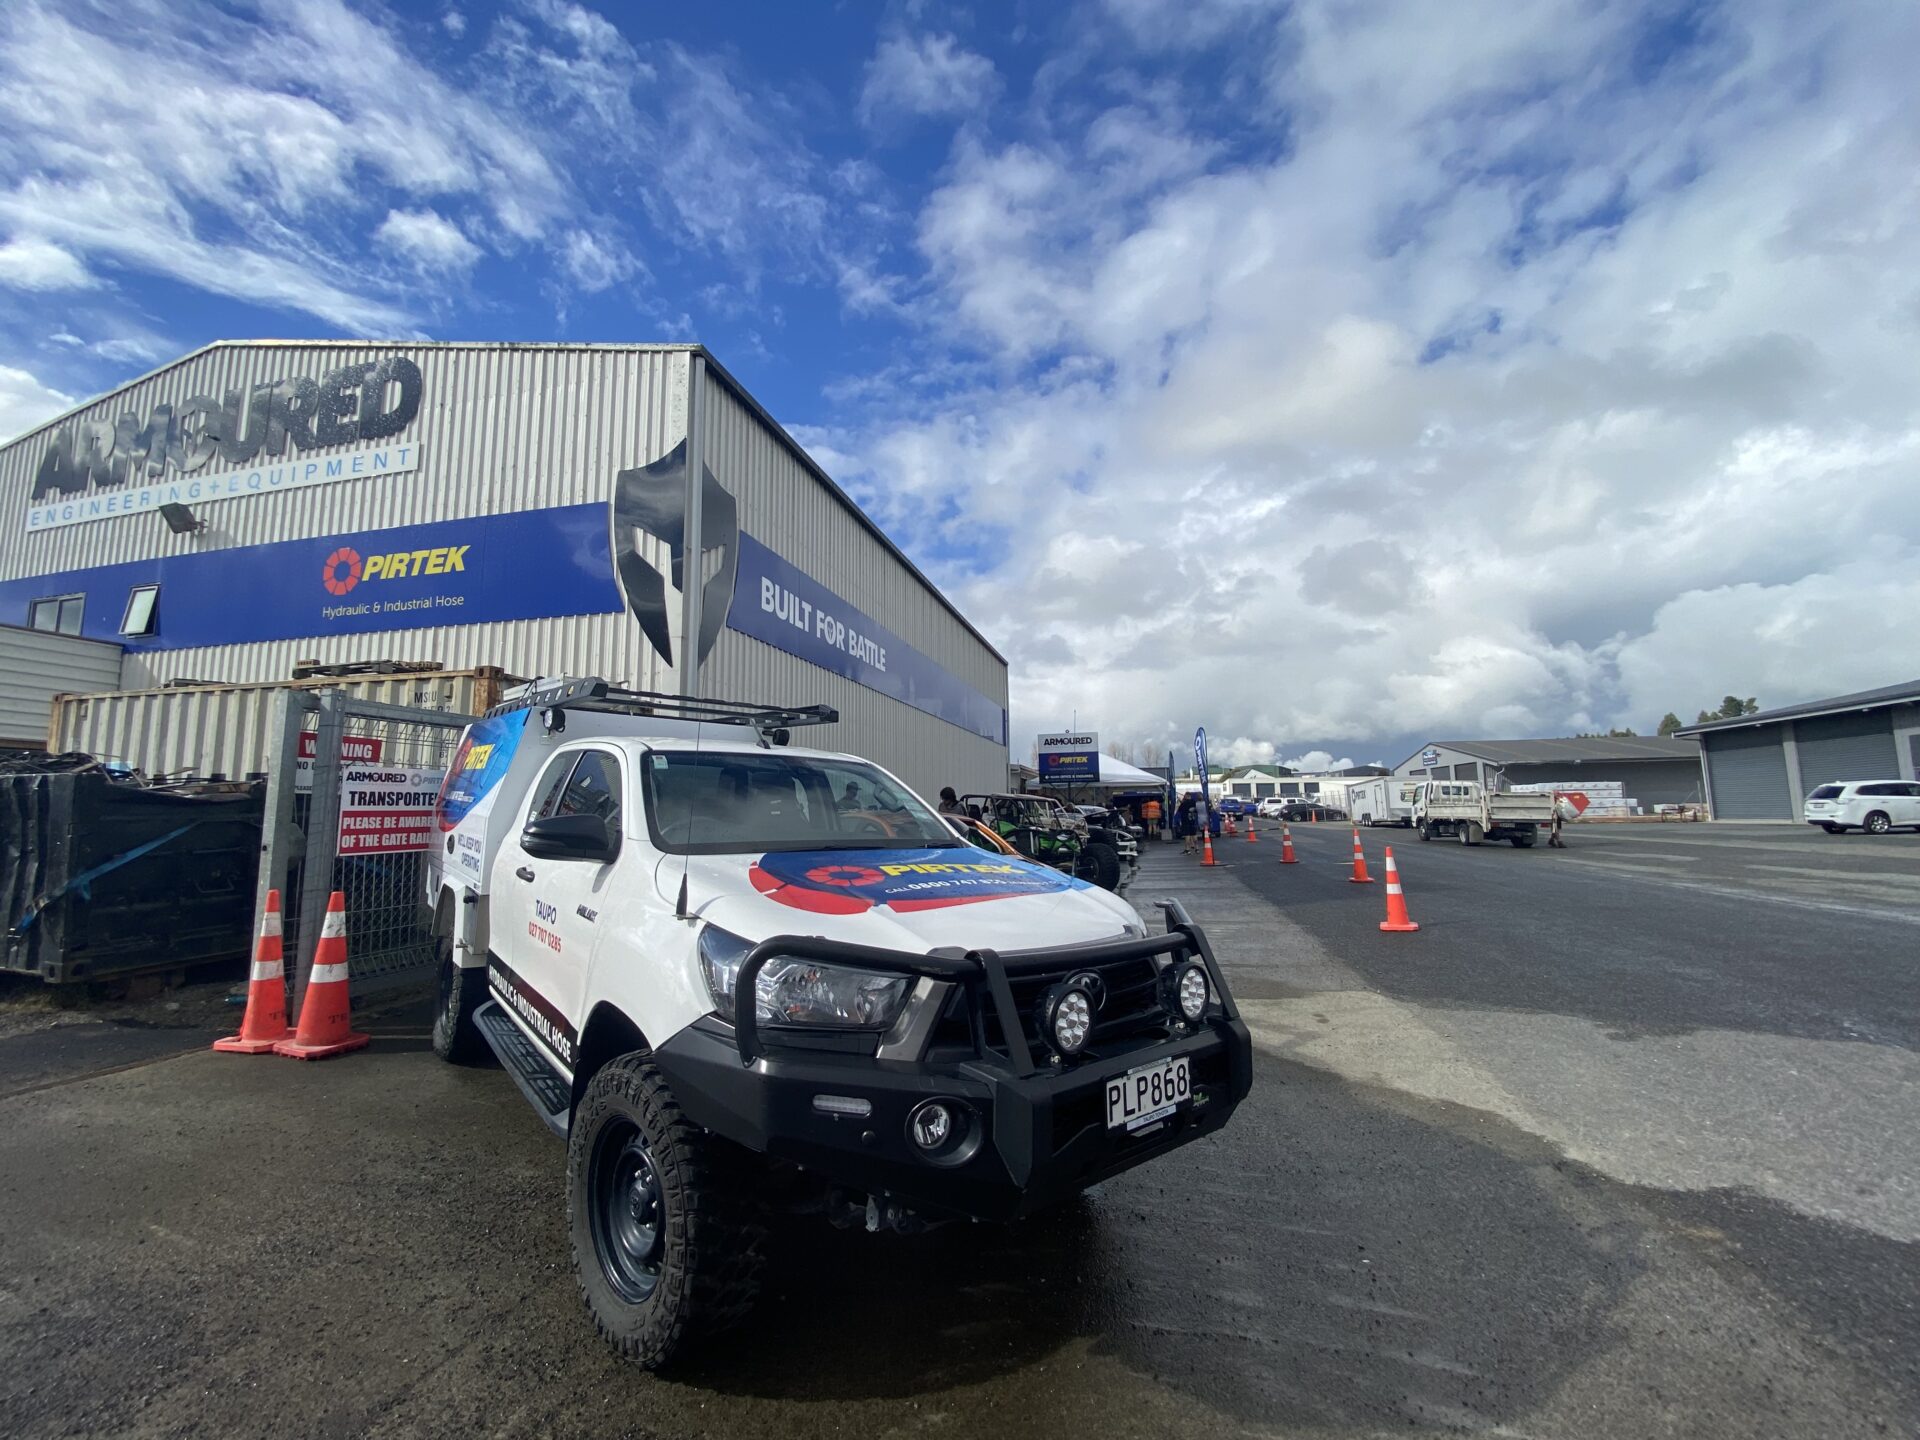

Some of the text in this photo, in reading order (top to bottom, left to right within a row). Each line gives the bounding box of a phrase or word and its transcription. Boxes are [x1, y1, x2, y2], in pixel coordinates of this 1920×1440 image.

[31, 356, 423, 501] ARMOURED
[361, 545, 471, 582] PIRTEK
[322, 595, 464, 620] Hydraulic & Industrial Hose
[761, 575, 886, 673] BUILT FOR BATTLE
[305, 739, 372, 758] WNING
[1043, 737, 1092, 746] ARMOURED
[1059, 756, 1088, 764] PIRTEK
[346, 771, 443, 785] ARMOURED PIRT
[349, 791, 437, 807] TRANSPORTE
[343, 816, 381, 830] PLEASE
[384, 816, 397, 828] BE
[341, 835, 356, 848] OF
[359, 834, 379, 847] THE
[382, 833, 408, 846] GATE
[879, 863, 1027, 877] PIRTEK
[885, 885, 912, 894] CALL
[950, 879, 978, 887] 747
[536, 899, 557, 925] TAUPO
[489, 964, 514, 1003] HYDRAULIC
[517, 993, 552, 1043] INDUSTRIAL
[552, 1026, 572, 1063] HOSE
[1108, 1063, 1187, 1123] PLP868
